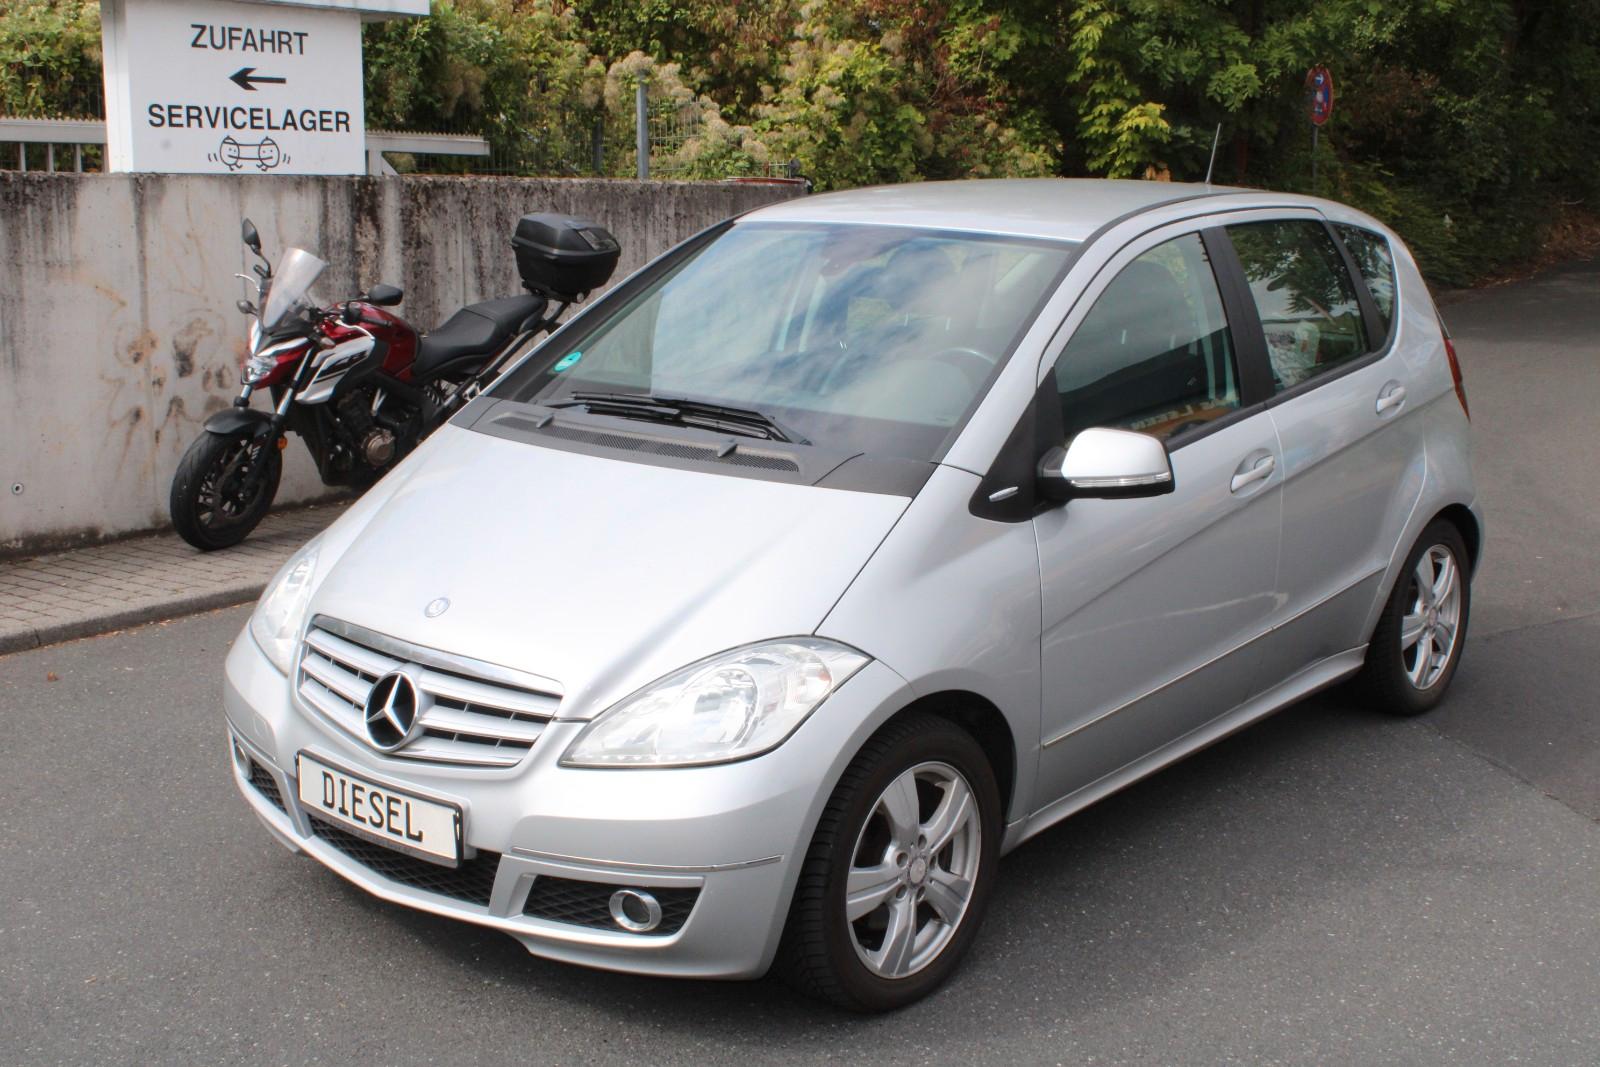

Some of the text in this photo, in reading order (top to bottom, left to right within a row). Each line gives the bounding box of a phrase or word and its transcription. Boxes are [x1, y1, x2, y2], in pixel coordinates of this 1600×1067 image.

[191, 24, 308, 55] ZUFAHRT
[148, 104, 350, 132] SERVICELAGER
[322, 770, 423, 842] DIESEL
